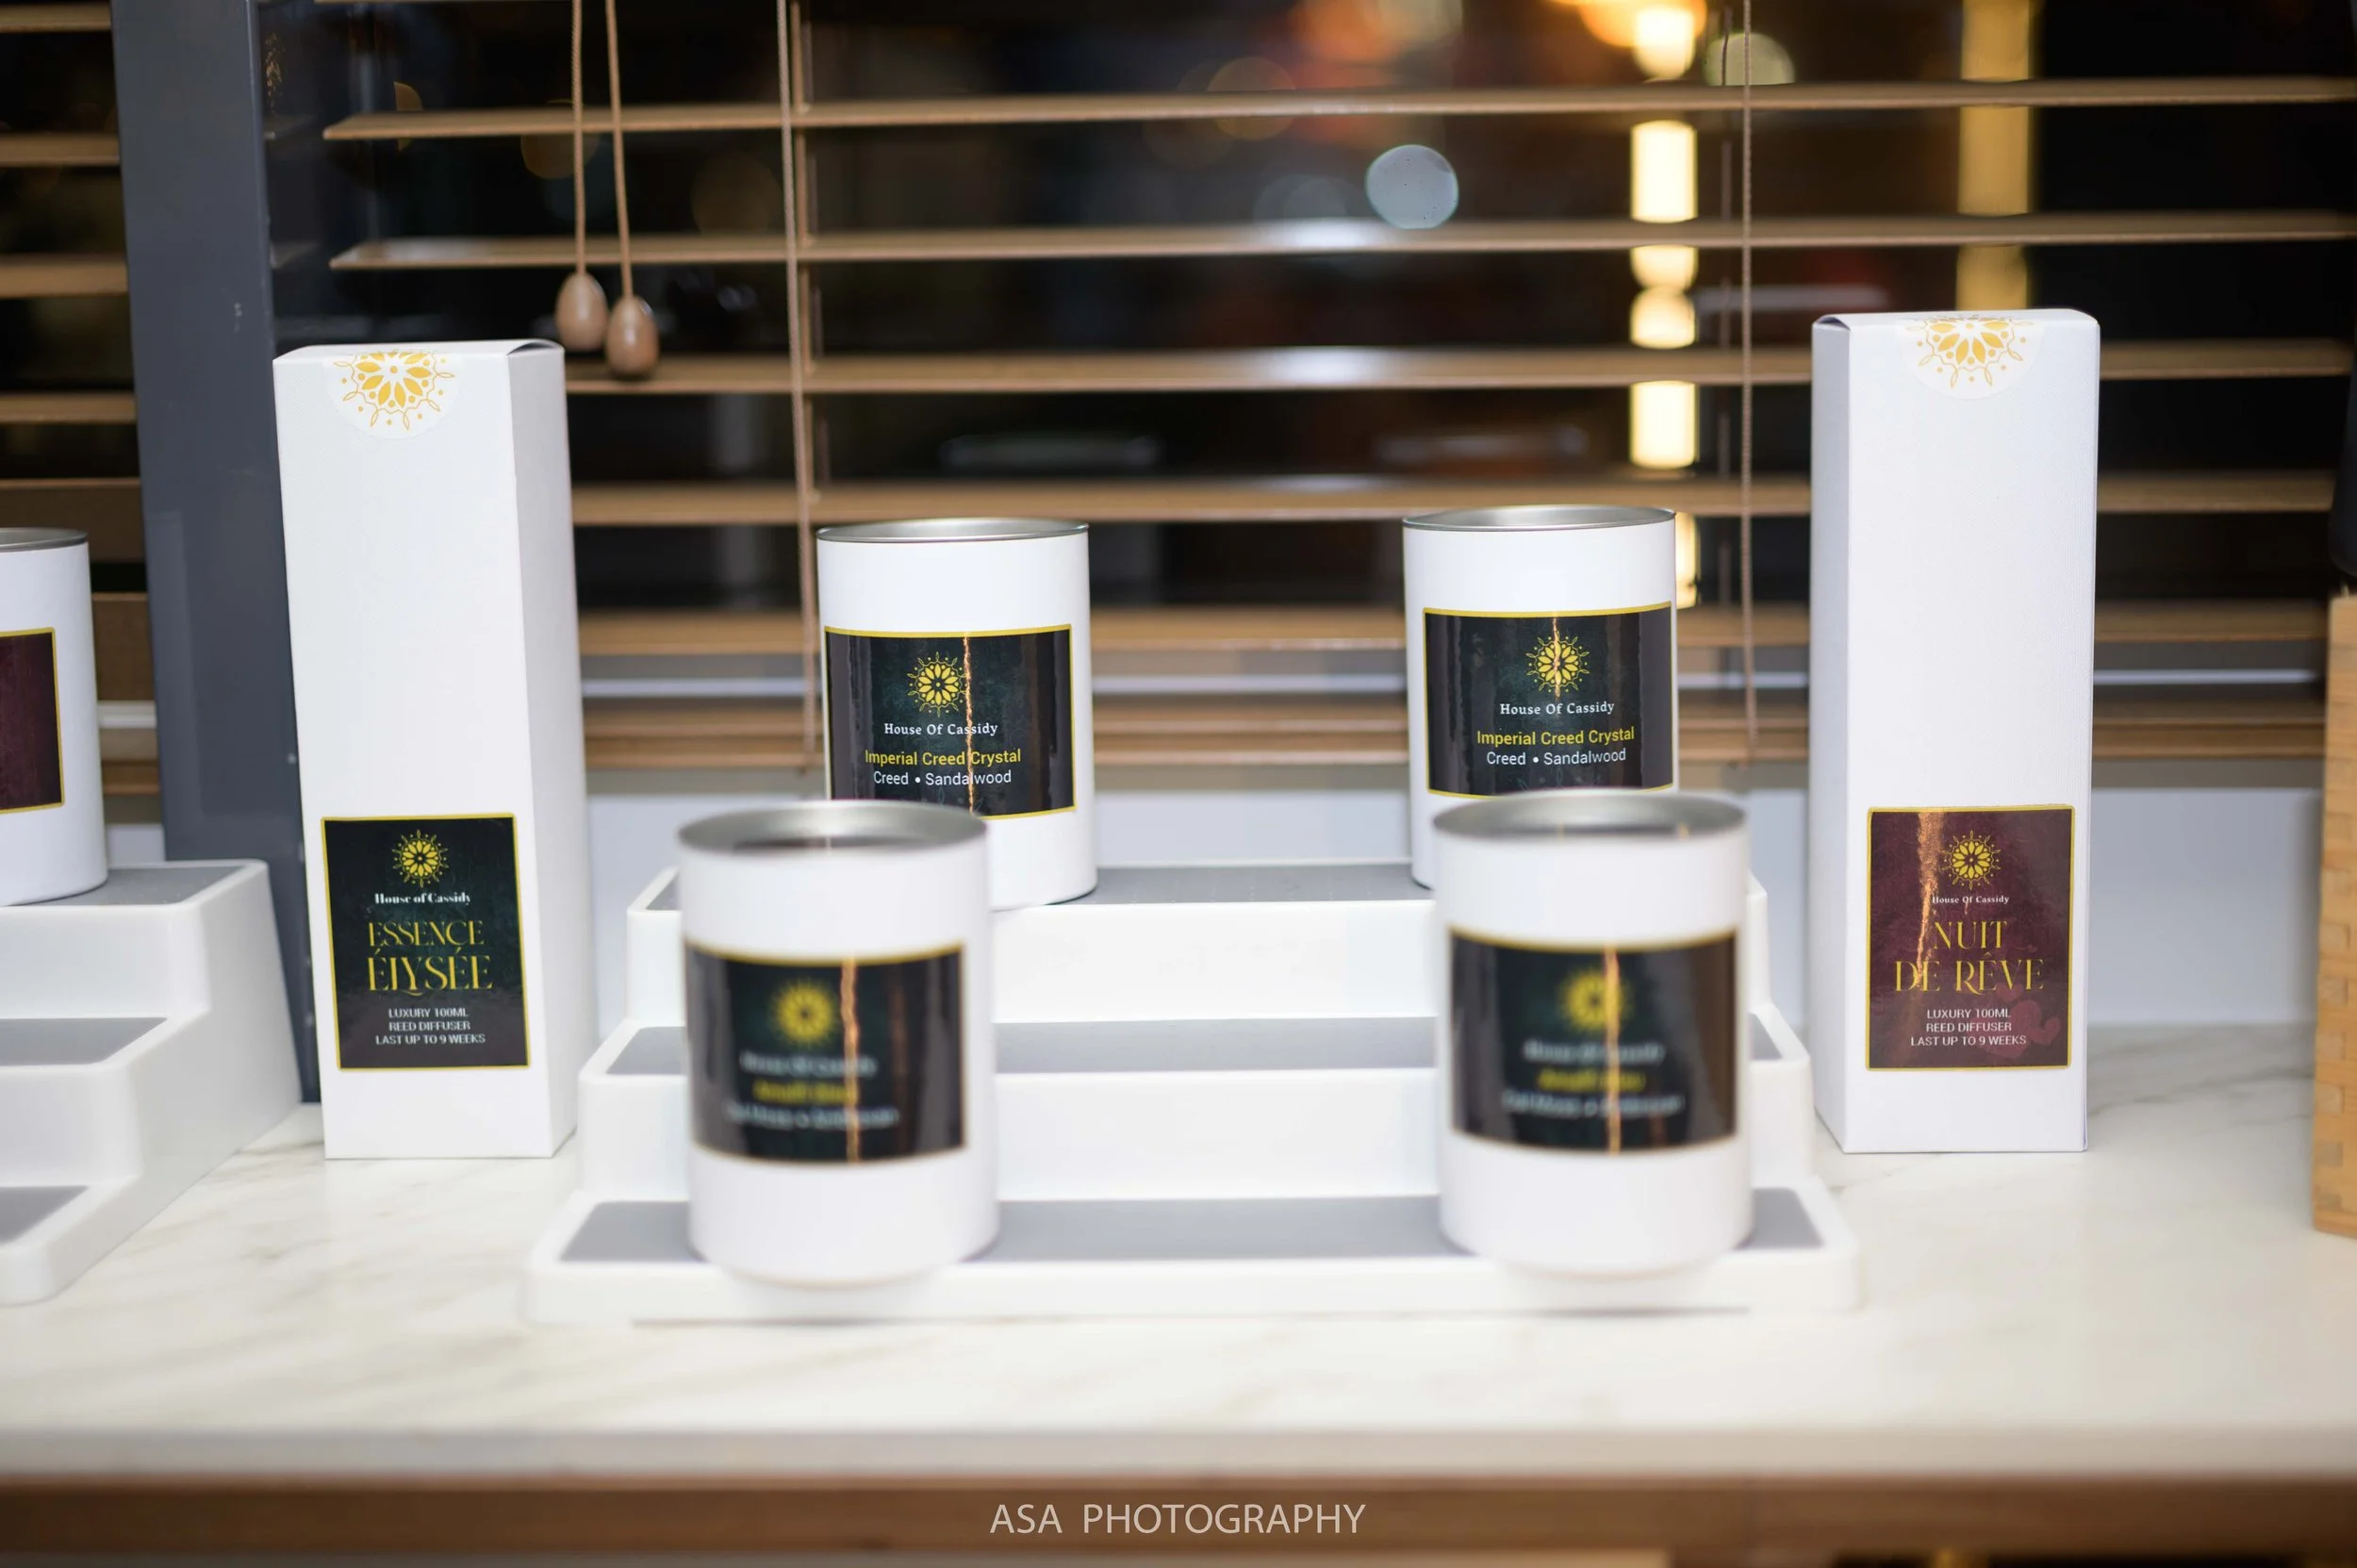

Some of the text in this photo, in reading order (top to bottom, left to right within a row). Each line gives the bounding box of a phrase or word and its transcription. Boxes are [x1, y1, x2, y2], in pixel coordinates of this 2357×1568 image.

[1499, 701, 1615, 715] House Of Cassidy
[883, 722, 998, 736] House Of Cassidy
[1477, 726, 1635, 748] Imperial Creed Crystal
[865, 748, 1021, 767] Imperial Creed Crystal
[1487, 748, 1626, 766] Creed Sandalwood
[873, 769, 1012, 785] Creed Sandalwood
[374, 892, 471, 906] House of Cassidy
[1932, 895, 2009, 905] House Of Cassidy
[368, 919, 485, 947] ESSENCE
[1934, 920, 2007, 949] NUIT
[1894, 951, 2044, 996] DE RÊVE
[388, 1007, 470, 1018] LUXURY 100ML
[1927, 1008, 2011, 1019] LUXURY 100ML
[388, 1020, 470, 1032] REED DIFFUSER
[1925, 1022, 2012, 1032] REED DIFFUSER
[375, 1033, 486, 1046] LAST UP TO 9 WEEKS
[1910, 1035, 2027, 1047] LAST UP TO 9 WEEKS
